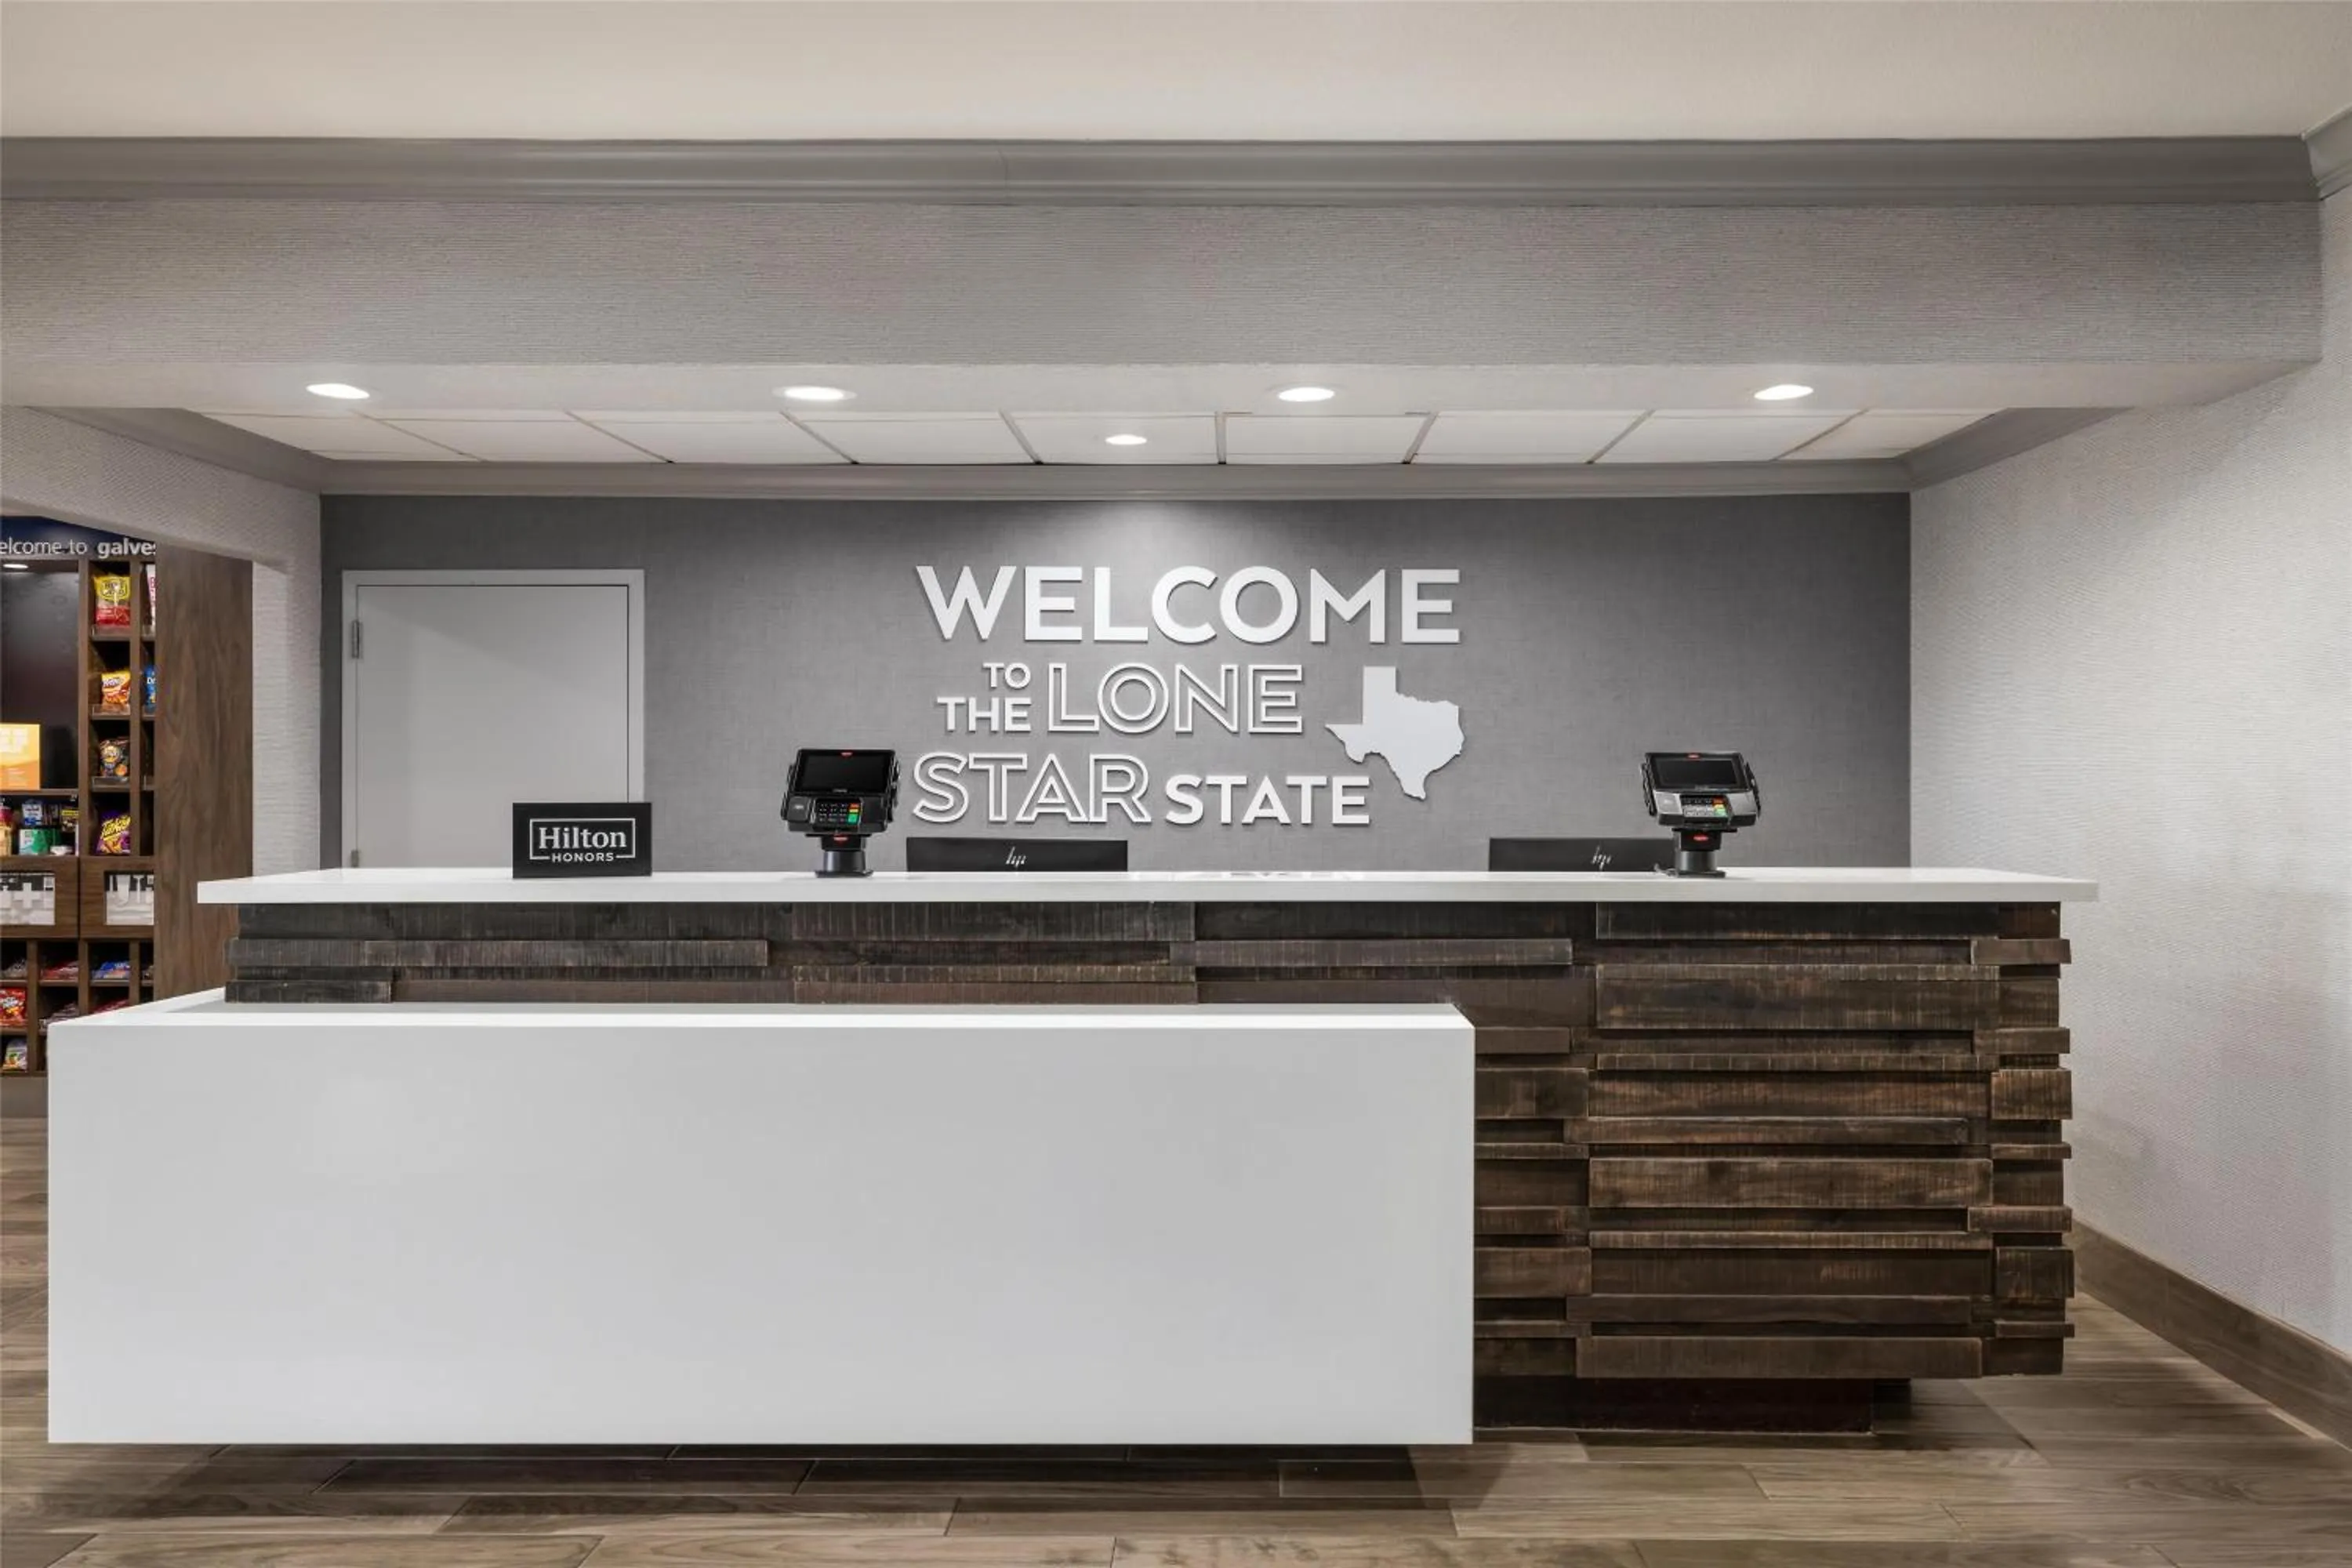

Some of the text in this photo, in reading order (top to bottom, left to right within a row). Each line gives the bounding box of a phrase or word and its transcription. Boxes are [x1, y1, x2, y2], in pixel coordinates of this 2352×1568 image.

[69, 539, 88, 555] to
[916, 565, 1460, 644] WELCOME
[983, 662, 1031, 688] TO
[938, 663, 1302, 733] THE LONE
[913, 753, 1370, 825] STAR STATE
[539, 827, 627, 849] Hilton
[551, 852, 615, 862] HONORS
[1005, 846, 1026, 868] hp
